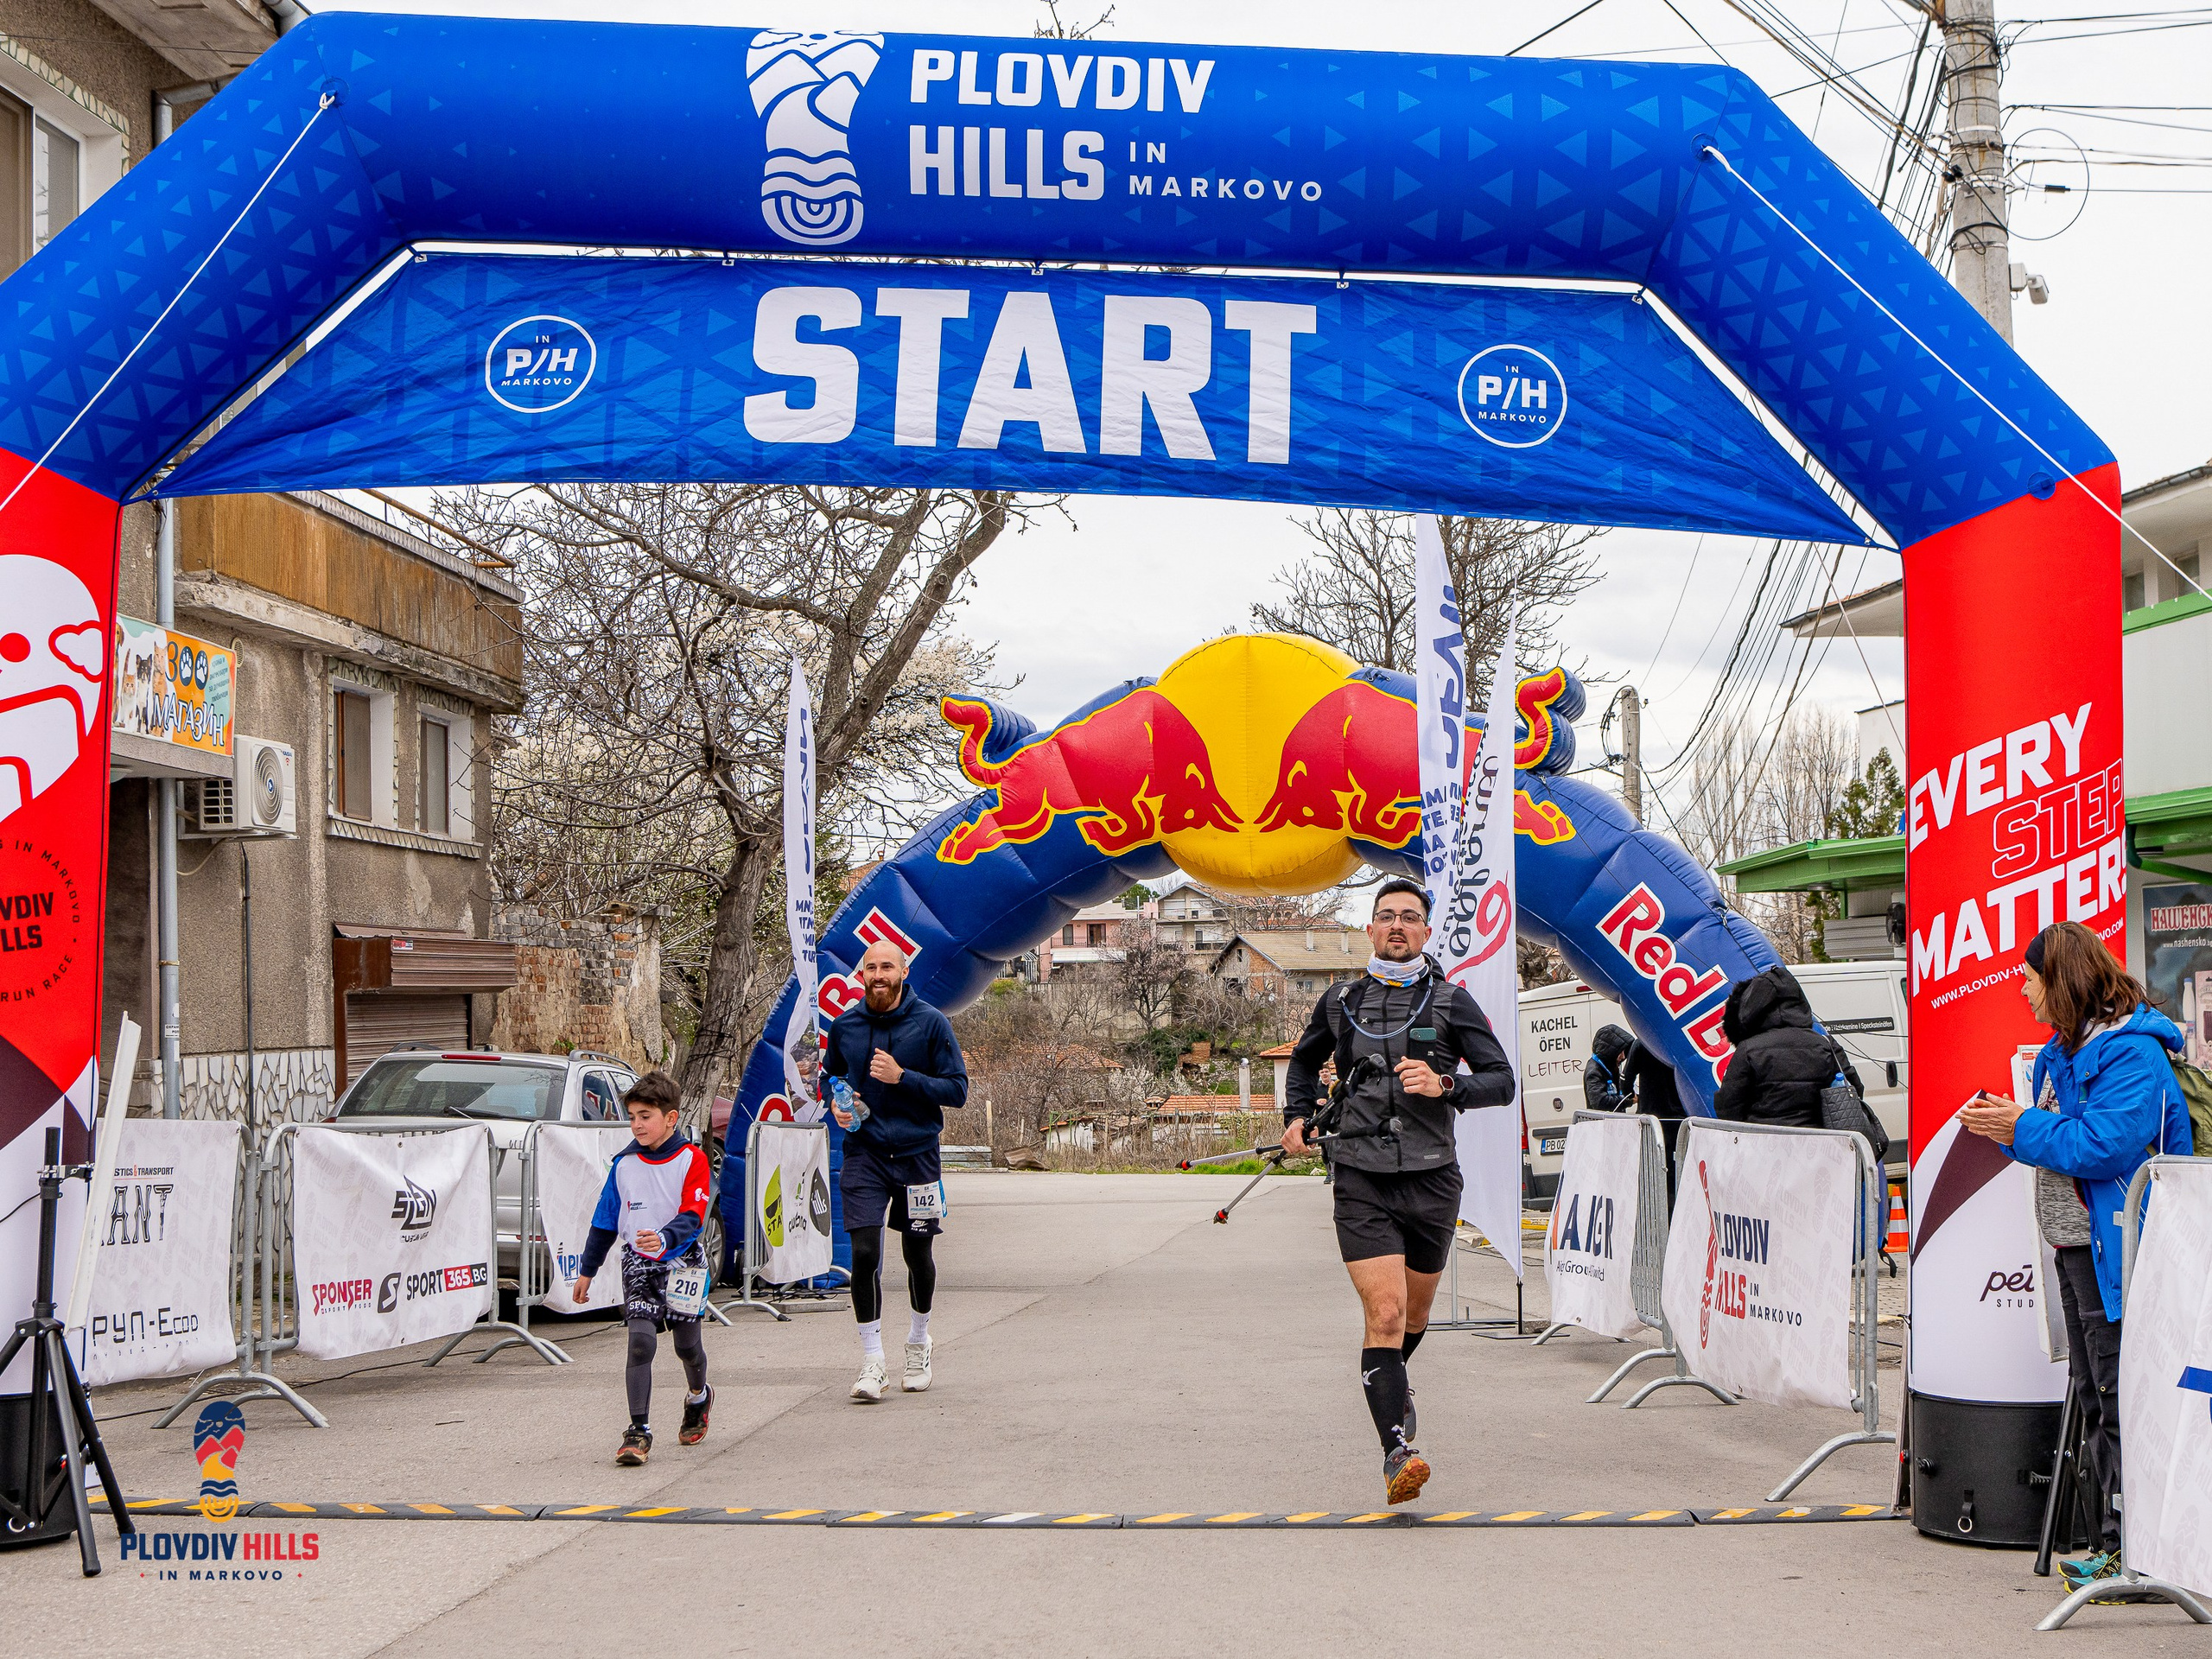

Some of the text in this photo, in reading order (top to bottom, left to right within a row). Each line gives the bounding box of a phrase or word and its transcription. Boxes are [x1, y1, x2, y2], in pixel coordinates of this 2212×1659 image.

[910, 48, 1216, 114] PLOVDIV
[909, 124, 1104, 201] HILLS
[1129, 142, 1166, 163] IN
[1128, 175, 1322, 202] MARKOVO
[535, 335, 550, 344] IN
[505, 347, 578, 378] P/H
[743, 286, 1317, 465] START
[1505, 365, 1519, 373] IN
[501, 378, 572, 386] MARKOVO
[1478, 375, 1547, 410] P/H
[1478, 411, 1547, 423] MARKOVO
[153, 692, 225, 747] МАГАЗИН
[1910, 702, 2093, 854] EVERY
[1992, 758, 2124, 879] STEP
[15, 840, 80, 923] IN MARKOVO
[0, 892, 54, 921] VDIV
[1595, 881, 1729, 1020] Red
[42, 954, 73, 991] RACE
[1531, 1015, 1578, 1033] KACHEL
[1539, 1036, 1571, 1052] ÖFEN
[1557, 1139, 1567, 1150] 02
[913, 1194, 935, 1207] 142
[101, 1184, 174, 1246] ANT
[312, 1279, 372, 1316] SPONSER
[406, 1268, 443, 1301] SPORT
[675, 1279, 698, 1296] 218
[1750, 1282, 1759, 1297] IN
[629, 1300, 660, 1314] SPORT
[1750, 1303, 1802, 1326] MARKOVO
[1996, 1299, 2034, 1308] STUD
